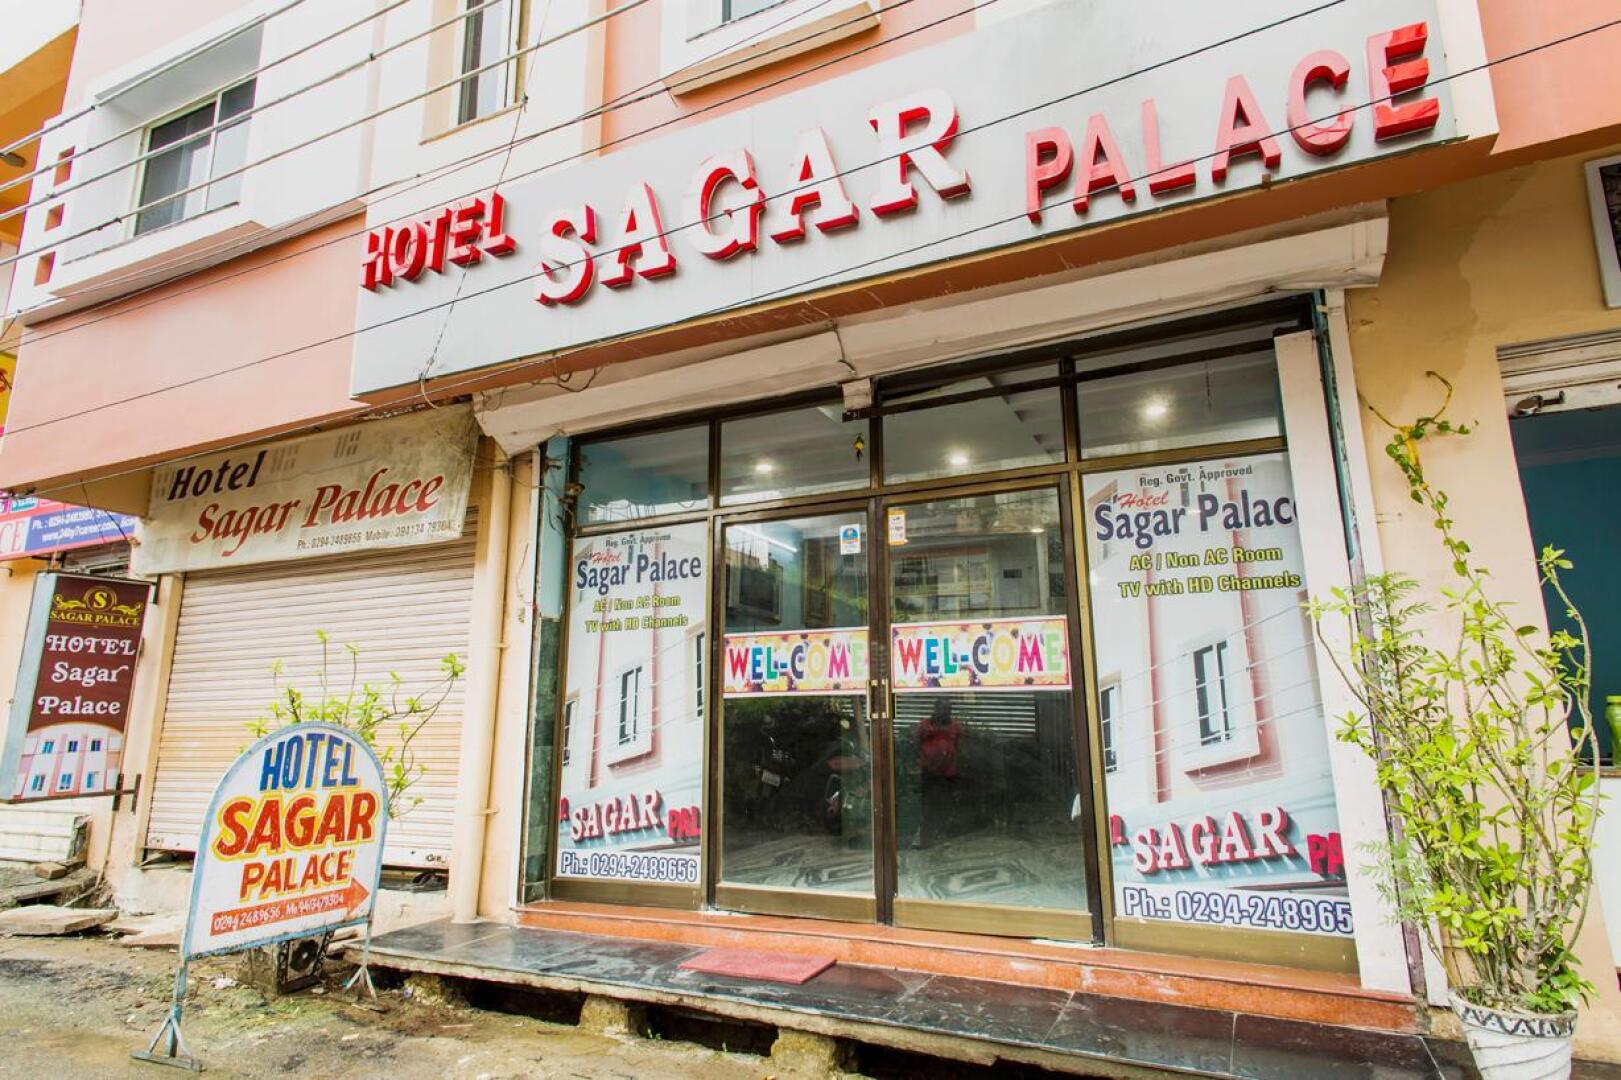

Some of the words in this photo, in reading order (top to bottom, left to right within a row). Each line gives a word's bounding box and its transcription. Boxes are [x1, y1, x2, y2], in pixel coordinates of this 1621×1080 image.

[361, 190, 516, 292] HOTEL
[535, 84, 972, 307] SAGAR
[1024, 21, 1440, 223] PALACE
[168, 450, 267, 501] Hotel
[1139, 476, 1163, 488] Reg.
[1166, 472, 1195, 484] Govt.
[1199, 465, 1253, 482] Approved
[190, 500, 301, 557] Sagar
[300, 467, 444, 529] Palace
[1117, 490, 1169, 510] Hotel
[1094, 503, 1186, 549] Sagar
[1197, 489, 1299, 532] Palac
[576, 560, 630, 596] Sagar
[636, 551, 702, 583] Palace
[1129, 557, 1152, 571] AC
[1166, 552, 1200, 568] Non
[1204, 549, 1228, 565] AC
[1232, 547, 1283, 563] Room
[652, 594, 682, 607] Room
[1118, 582, 1141, 598] TV
[1145, 580, 1185, 596] with
[1188, 576, 1213, 593] HD
[1217, 569, 1302, 591] Channels
[50, 610, 93, 623] SAGAR
[95, 613, 141, 627] PALACE
[584, 620, 598, 633] TV
[599, 618, 622, 632] with
[624, 616, 640, 631] HD
[643, 613, 689, 629] Channels
[45, 634, 136, 656] HOTEL
[729, 642, 867, 679] WEL-COME
[899, 632, 1065, 675] WEL-COME
[51, 661, 129, 687] Sagar
[37, 695, 121, 715] Palace
[259, 732, 359, 792] HOTEL
[214, 791, 378, 857] SAGAR
[571, 790, 666, 843] SAGAR
[1133, 806, 1300, 875] SAGAR
[239, 849, 354, 901] PALACE
[561, 851, 588, 875] Ph.:
[589, 852, 698, 883] 0294-2489656
[1122, 886, 1173, 919] Ph.:
